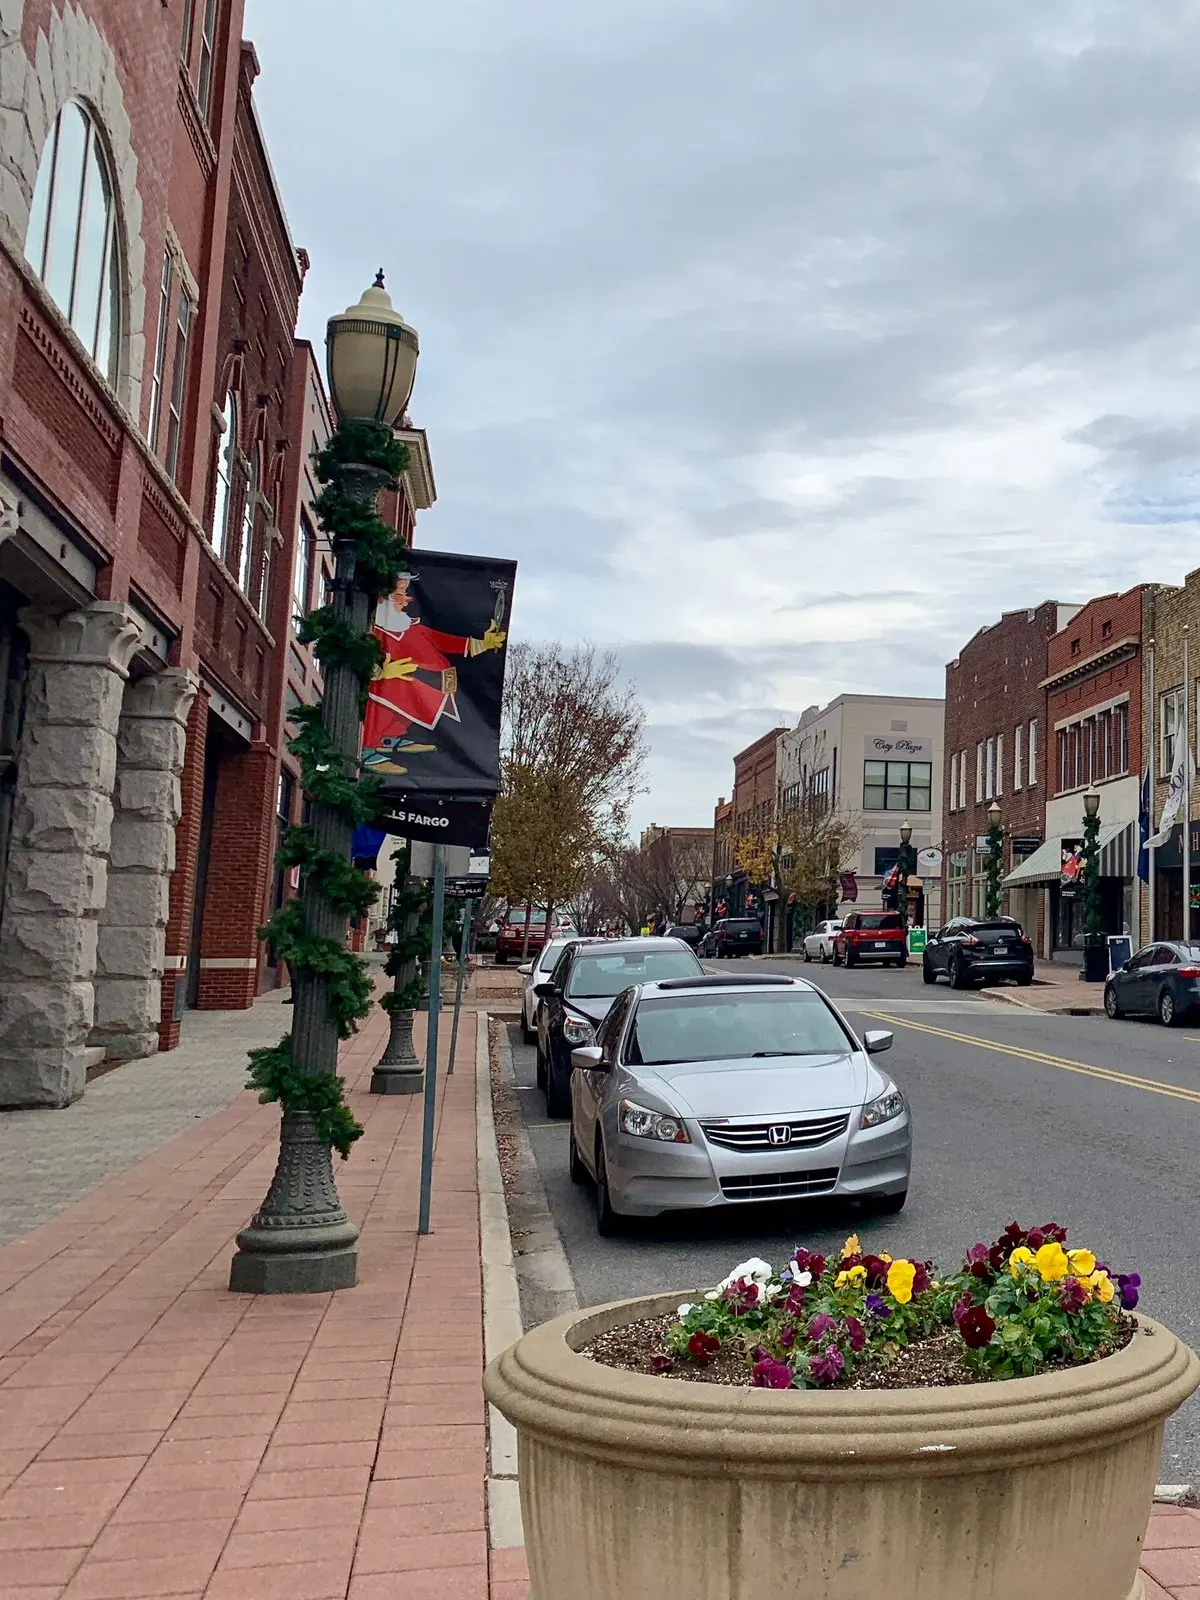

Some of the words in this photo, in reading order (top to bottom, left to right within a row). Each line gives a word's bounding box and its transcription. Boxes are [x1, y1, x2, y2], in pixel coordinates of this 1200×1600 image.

[872, 738, 893, 754] City
[895, 739, 923, 755] Plaza
[407, 812, 449, 827] FARGO
